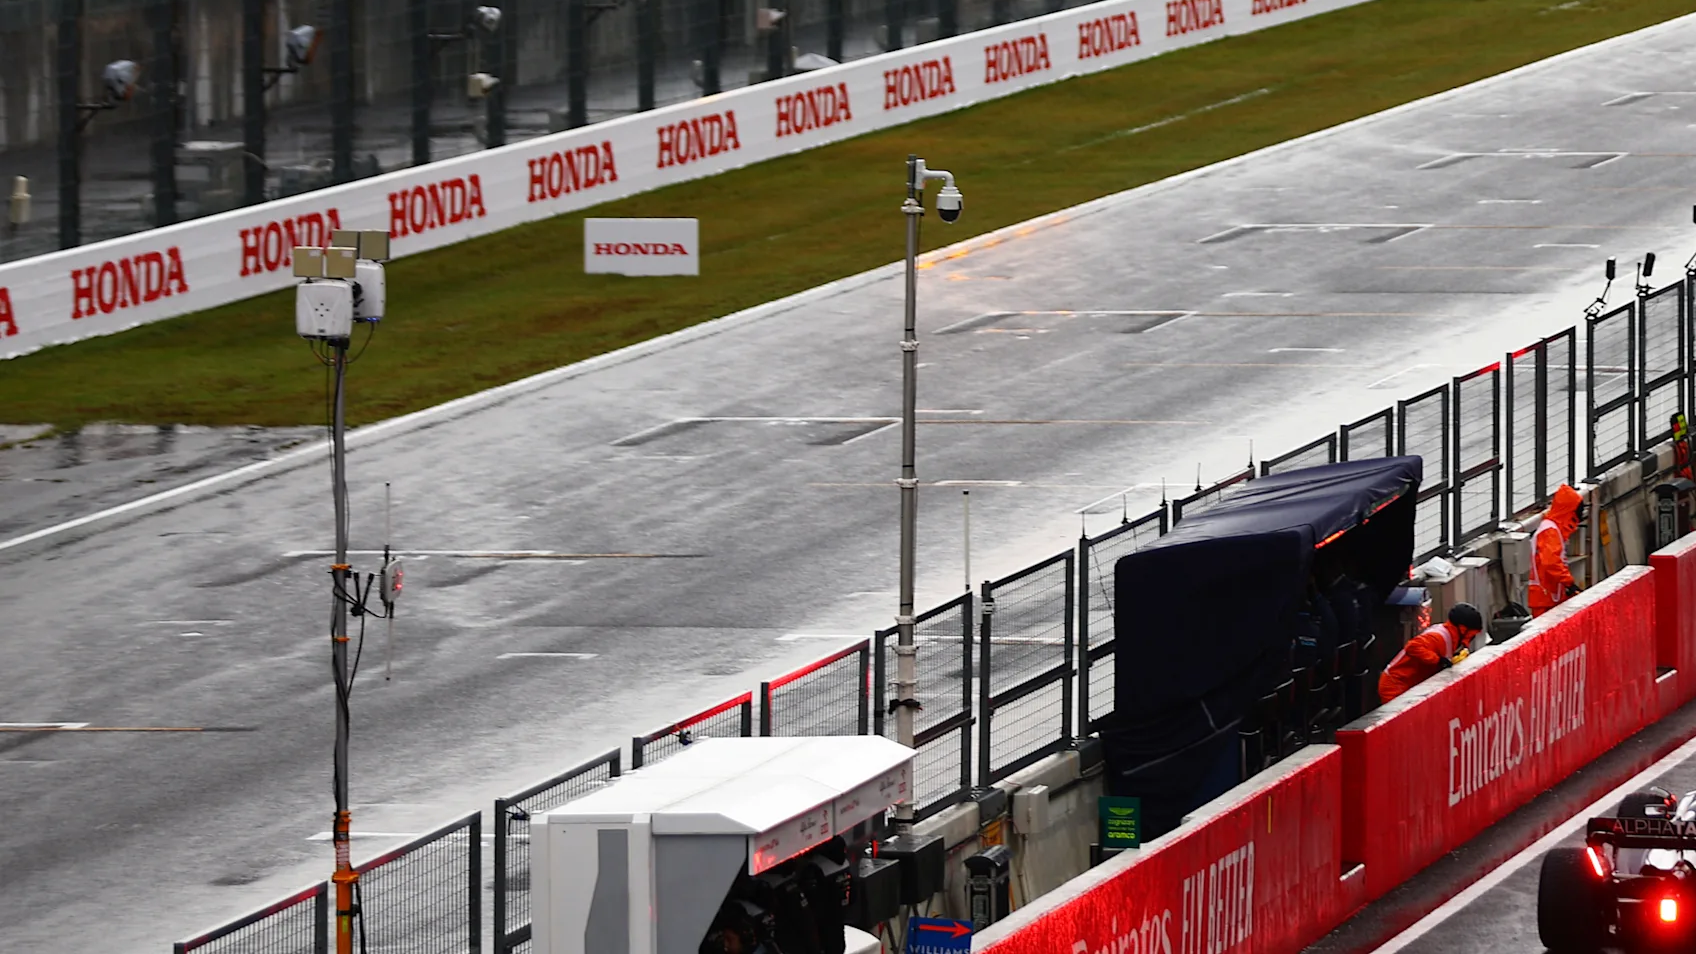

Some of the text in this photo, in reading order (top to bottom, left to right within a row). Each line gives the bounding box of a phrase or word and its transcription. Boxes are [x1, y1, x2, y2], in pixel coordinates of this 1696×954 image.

[984, 33, 1052, 84] HONDA
[1078, 11, 1141, 60] HONDA
[776, 82, 853, 138] HONDA
[884, 55, 956, 110] HONDA
[657, 110, 742, 169] HONDA
[527, 141, 619, 203] HONDA
[387, 174, 487, 240] HONDA
[593, 242, 689, 256] HONDA
[71, 246, 189, 320] HONDA
[1448, 696, 1524, 807] Emirates
[1107, 831, 1136, 839] aramco
